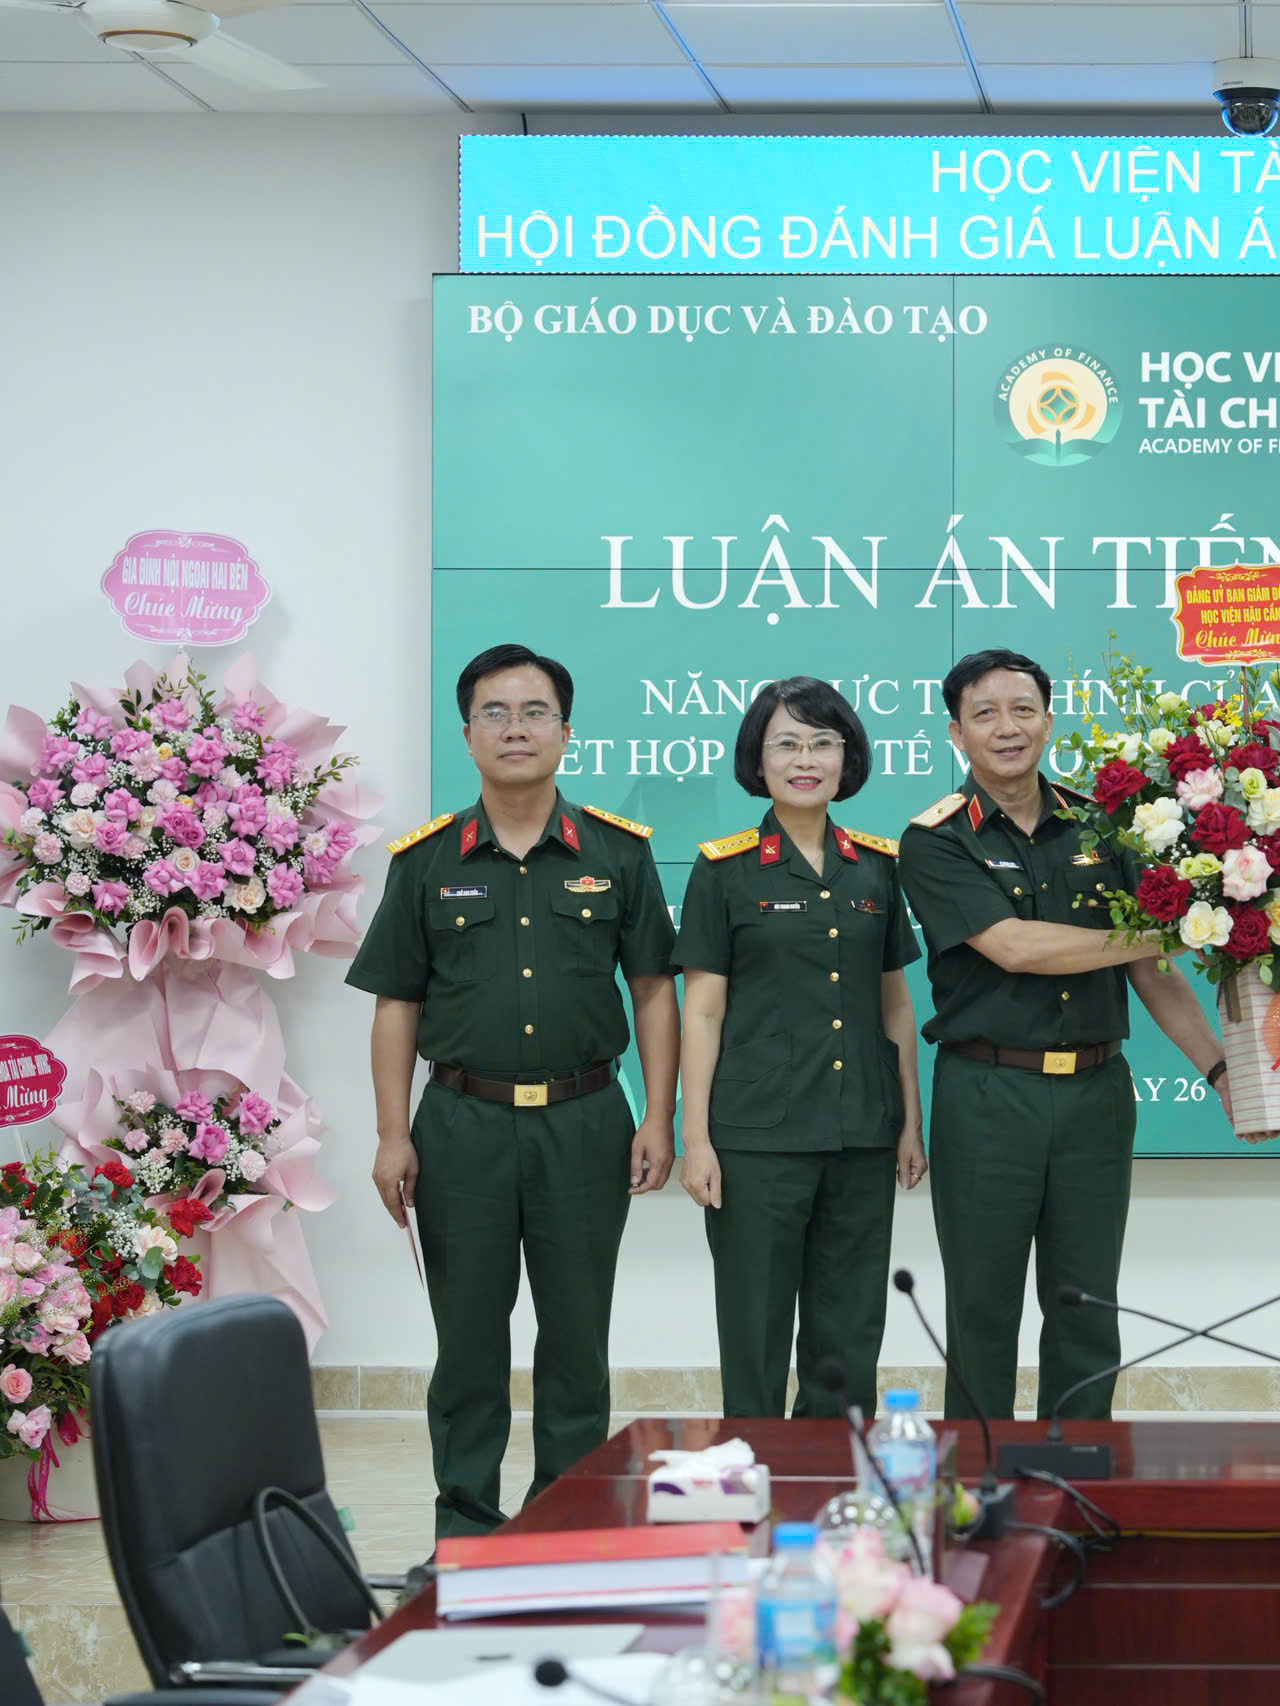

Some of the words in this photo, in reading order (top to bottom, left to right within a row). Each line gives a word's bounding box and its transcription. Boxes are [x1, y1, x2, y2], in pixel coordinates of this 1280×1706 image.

[932, 149, 1052, 202] HỌC
[1072, 145, 1201, 202] VIỆN
[478, 210, 574, 266] HỘI
[593, 204, 762, 260] ĐỒNG
[779, 206, 939, 259] ĐÁNH
[959, 206, 1056, 260] GIÁ
[1074, 209, 1220, 267] LUẬN
[468, 299, 523, 343] BỘ
[533, 297, 637, 336] GIÁO
[648, 304, 732, 344] DỤC
[742, 297, 797, 336] VÀ
[807, 297, 894, 336] ĐÀO
[904, 304, 989, 344] TẠO
[998, 349, 1047, 401] ACADEMY
[1054, 347, 1073, 358] OF
[1078, 352, 1119, 404] FINANCE
[1141, 350, 1232, 390] HỌC
[1138, 389, 1206, 429] TÀI
[1138, 438, 1233, 454] ACADEMY
[1237, 438, 1263, 454] OF
[600, 513, 888, 626] LUẬN
[913, 513, 1065, 610] ÁN
[124, 591, 176, 617] Chúc
[180, 594, 243, 627] Mừng
[1186, 584, 1212, 604] ĐẢNG
[1226, 588, 1246, 603] BAN
[1247, 584, 1271, 602] GIÁM
[1201, 609, 1219, 627] HỌC
[1221, 606, 1242, 627] VIỆN
[1243, 606, 1262, 626] HẬU
[1195, 629, 1238, 649] Chúc
[626, 736, 725, 782] HỢP
[873, 729, 934, 775] TẾ
[4, 1085, 50, 1108] Mừng
[1174, 1077, 1207, 1102] 26
